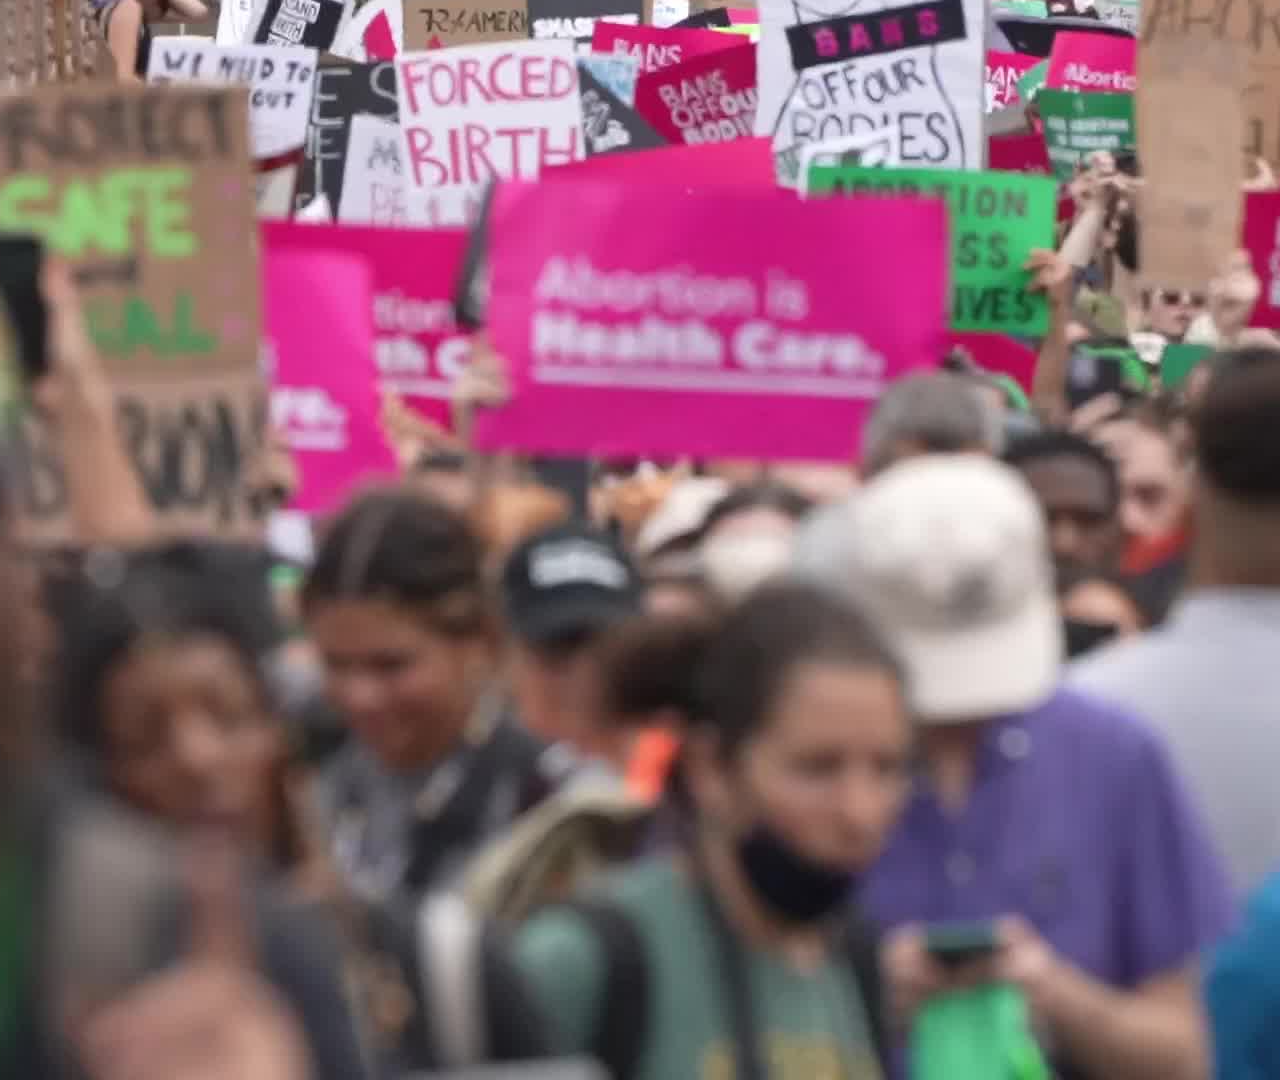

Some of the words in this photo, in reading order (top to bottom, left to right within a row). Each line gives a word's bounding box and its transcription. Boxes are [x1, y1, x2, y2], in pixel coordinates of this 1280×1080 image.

[613, 38, 682, 73] BANS
[810, 8, 941, 58] BANS
[286, 60, 311, 83] TO
[402, 53, 577, 115] FORCED
[800, 63, 858, 111] OFF
[863, 57, 927, 105] OUR
[406, 123, 580, 188] BIRTH
[535, 256, 756, 316] Abortion
[766, 267, 809, 317] is
[532, 319, 721, 367] Health
[731, 324, 887, 376] Care.
